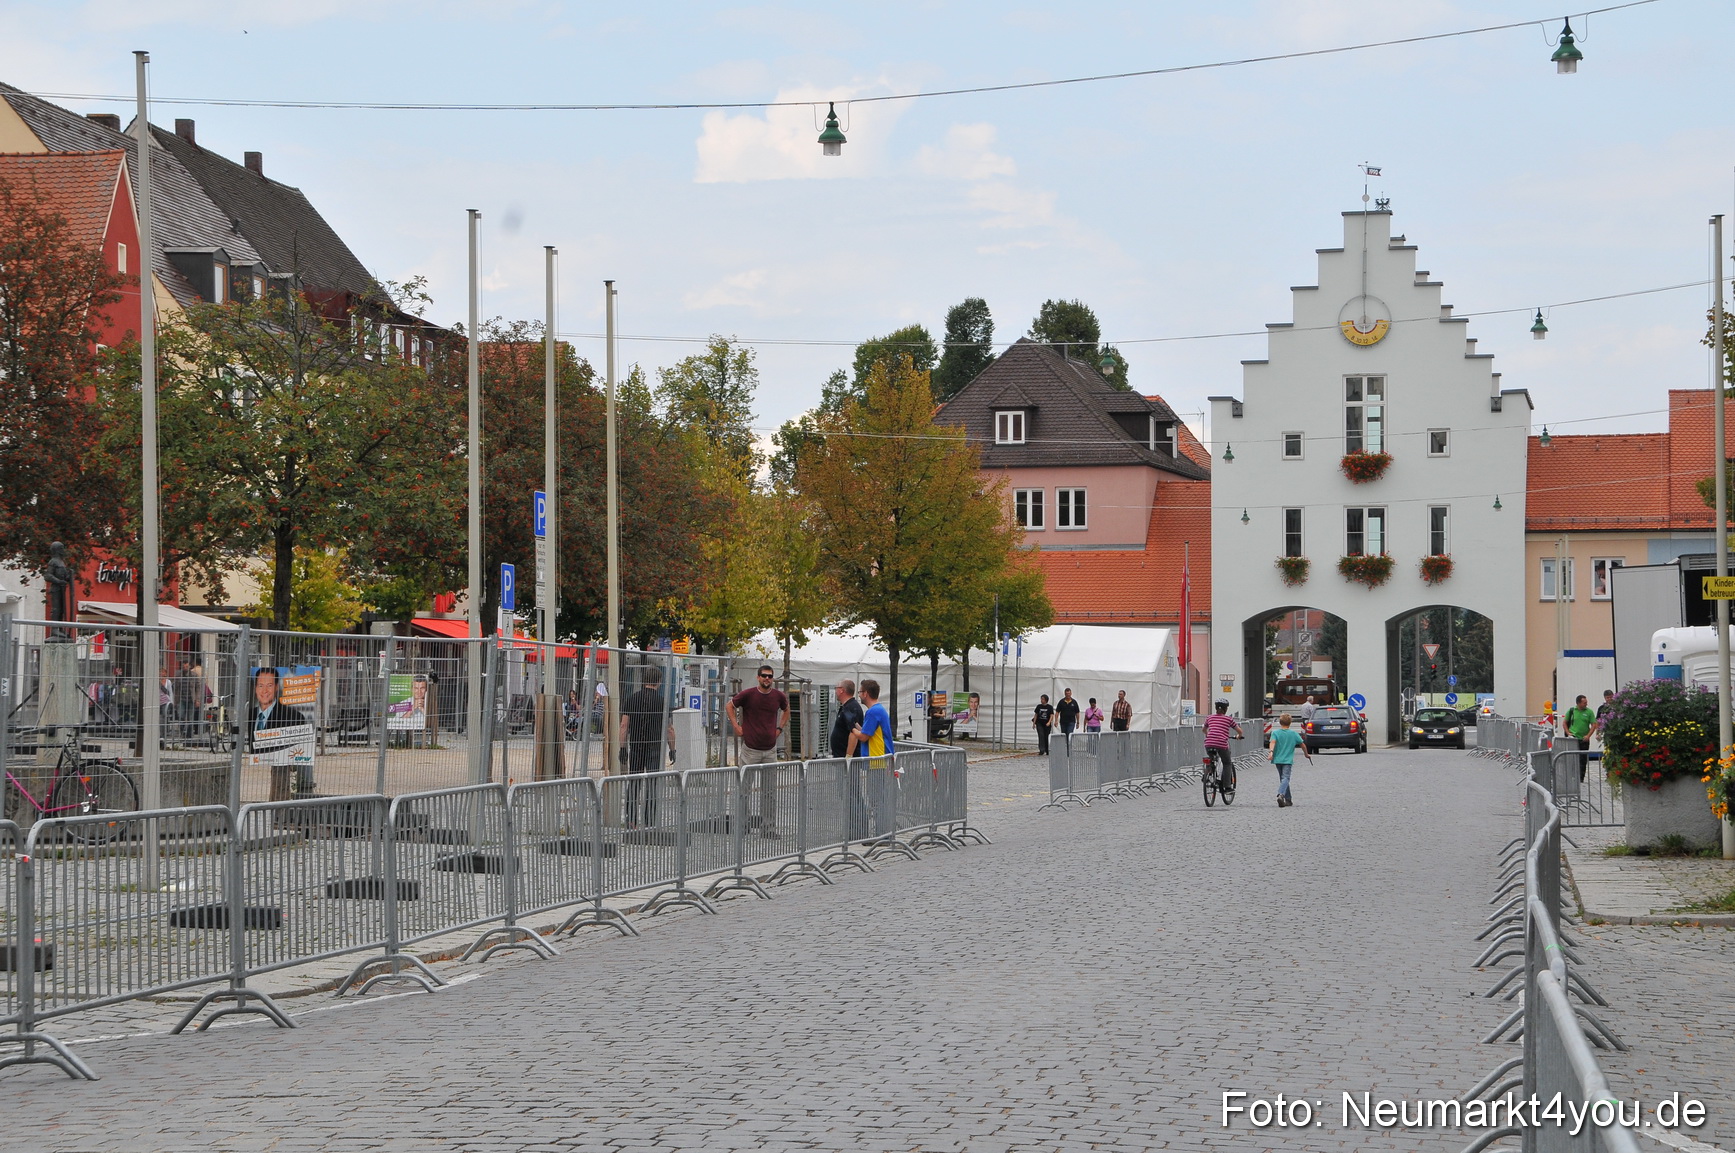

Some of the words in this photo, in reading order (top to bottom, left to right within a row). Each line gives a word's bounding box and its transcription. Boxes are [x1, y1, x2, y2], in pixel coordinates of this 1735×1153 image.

[537, 497, 546, 531] P
[504, 570, 512, 604] P
[285, 677, 312, 686] Thomas
[692, 698, 699, 708] P
[917, 694, 922, 702] P
